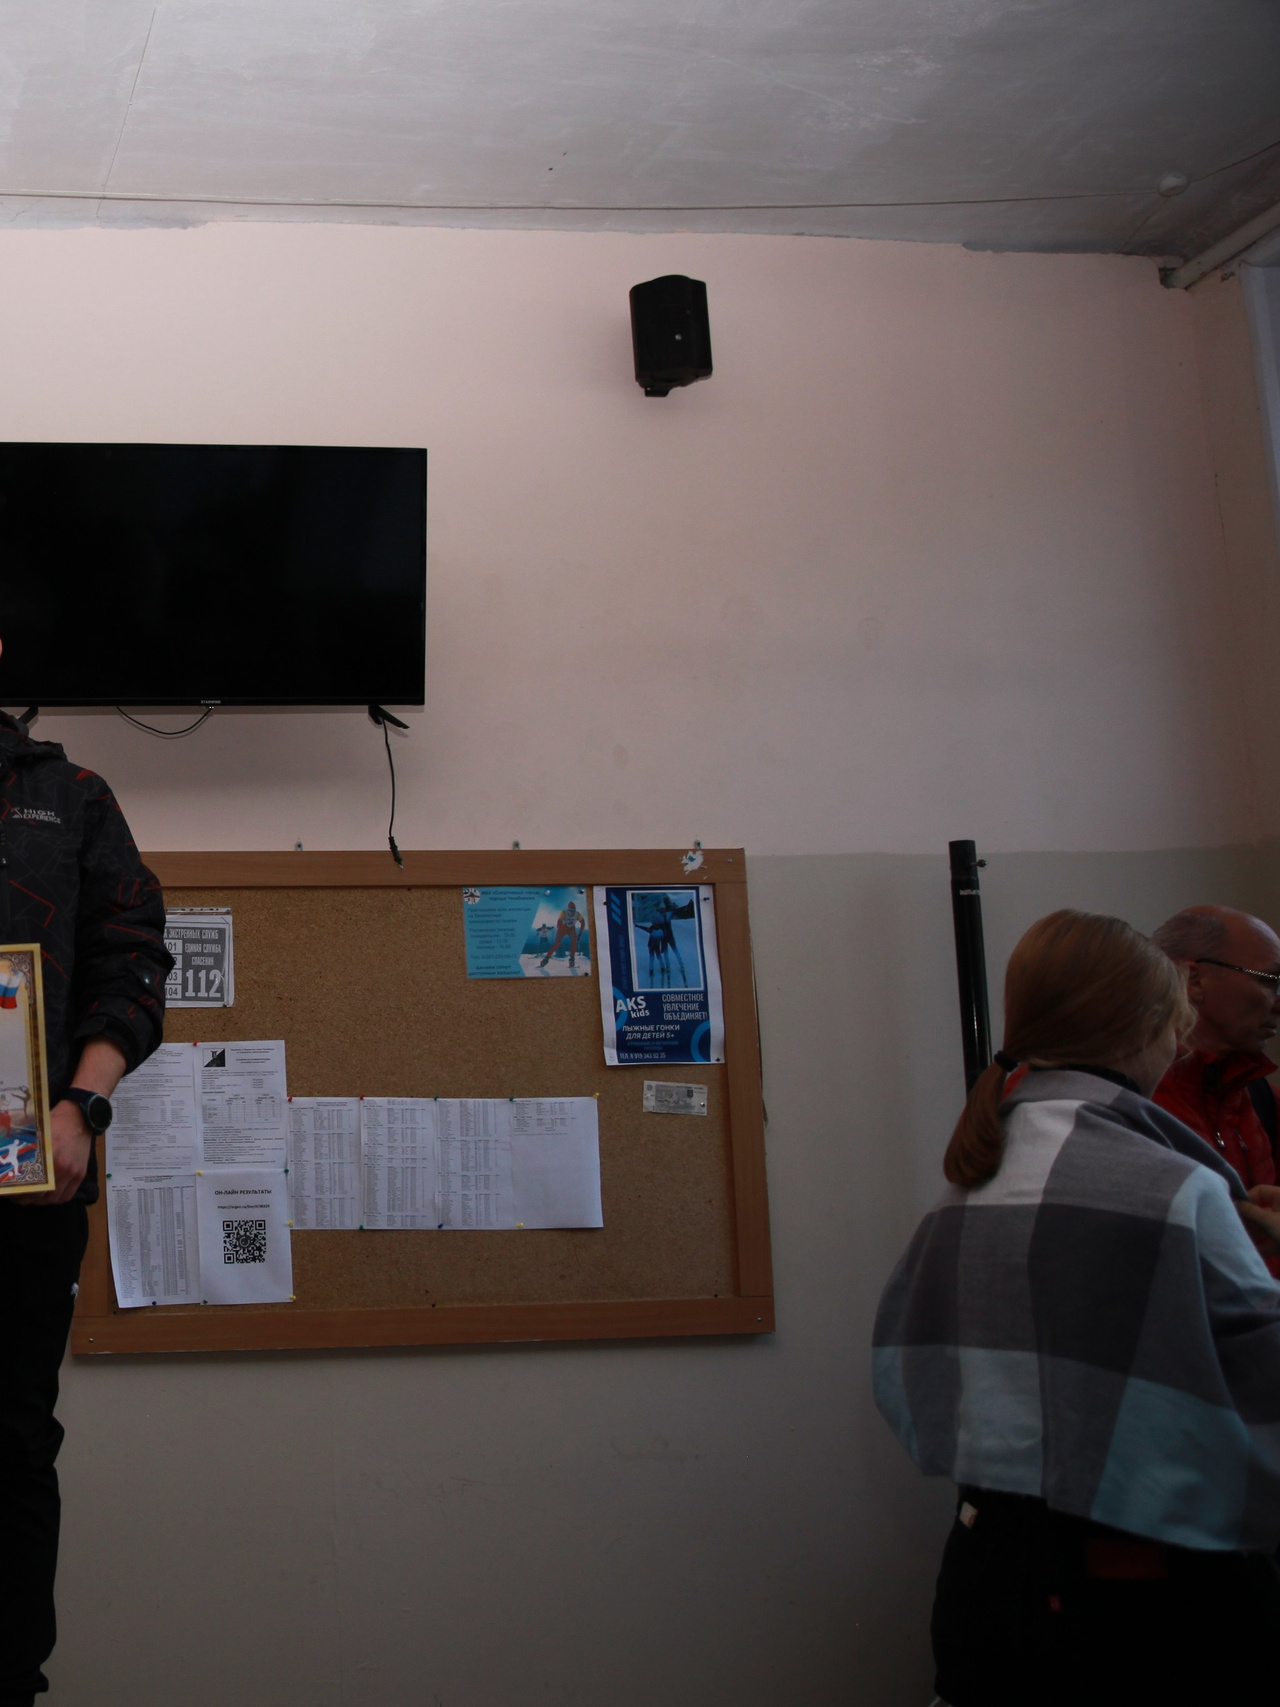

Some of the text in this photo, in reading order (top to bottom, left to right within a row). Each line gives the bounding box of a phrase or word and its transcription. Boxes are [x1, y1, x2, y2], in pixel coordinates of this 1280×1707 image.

[24, 808, 55, 817] HIGH
[23, 813, 61, 824] EXPERIENCE
[168, 928, 201, 940] ЭКСТРЕННЫХ
[201, 929, 219, 940] СЛУЖБ
[184, 943, 222, 953] ЕДИНАЯ СЛУЖБА
[191, 956, 214, 966] СПАСЕНИЯ
[185, 969, 221, 998] 112
[662, 993, 704, 1002] СОВМЕСТНОЕ
[616, 995, 647, 1013] AKS
[662, 1002, 700, 1012] УВЛЕЧЕНИЕ
[630, 1009, 650, 1019] kids
[663, 1011, 708, 1021] ОБЪЕДИНЯЕТ!
[622, 1024, 655, 1032] ЛЫЖНЫЕ
[625, 1031, 675, 1041] ДЛЯ ДЕТЕЙ 5+
